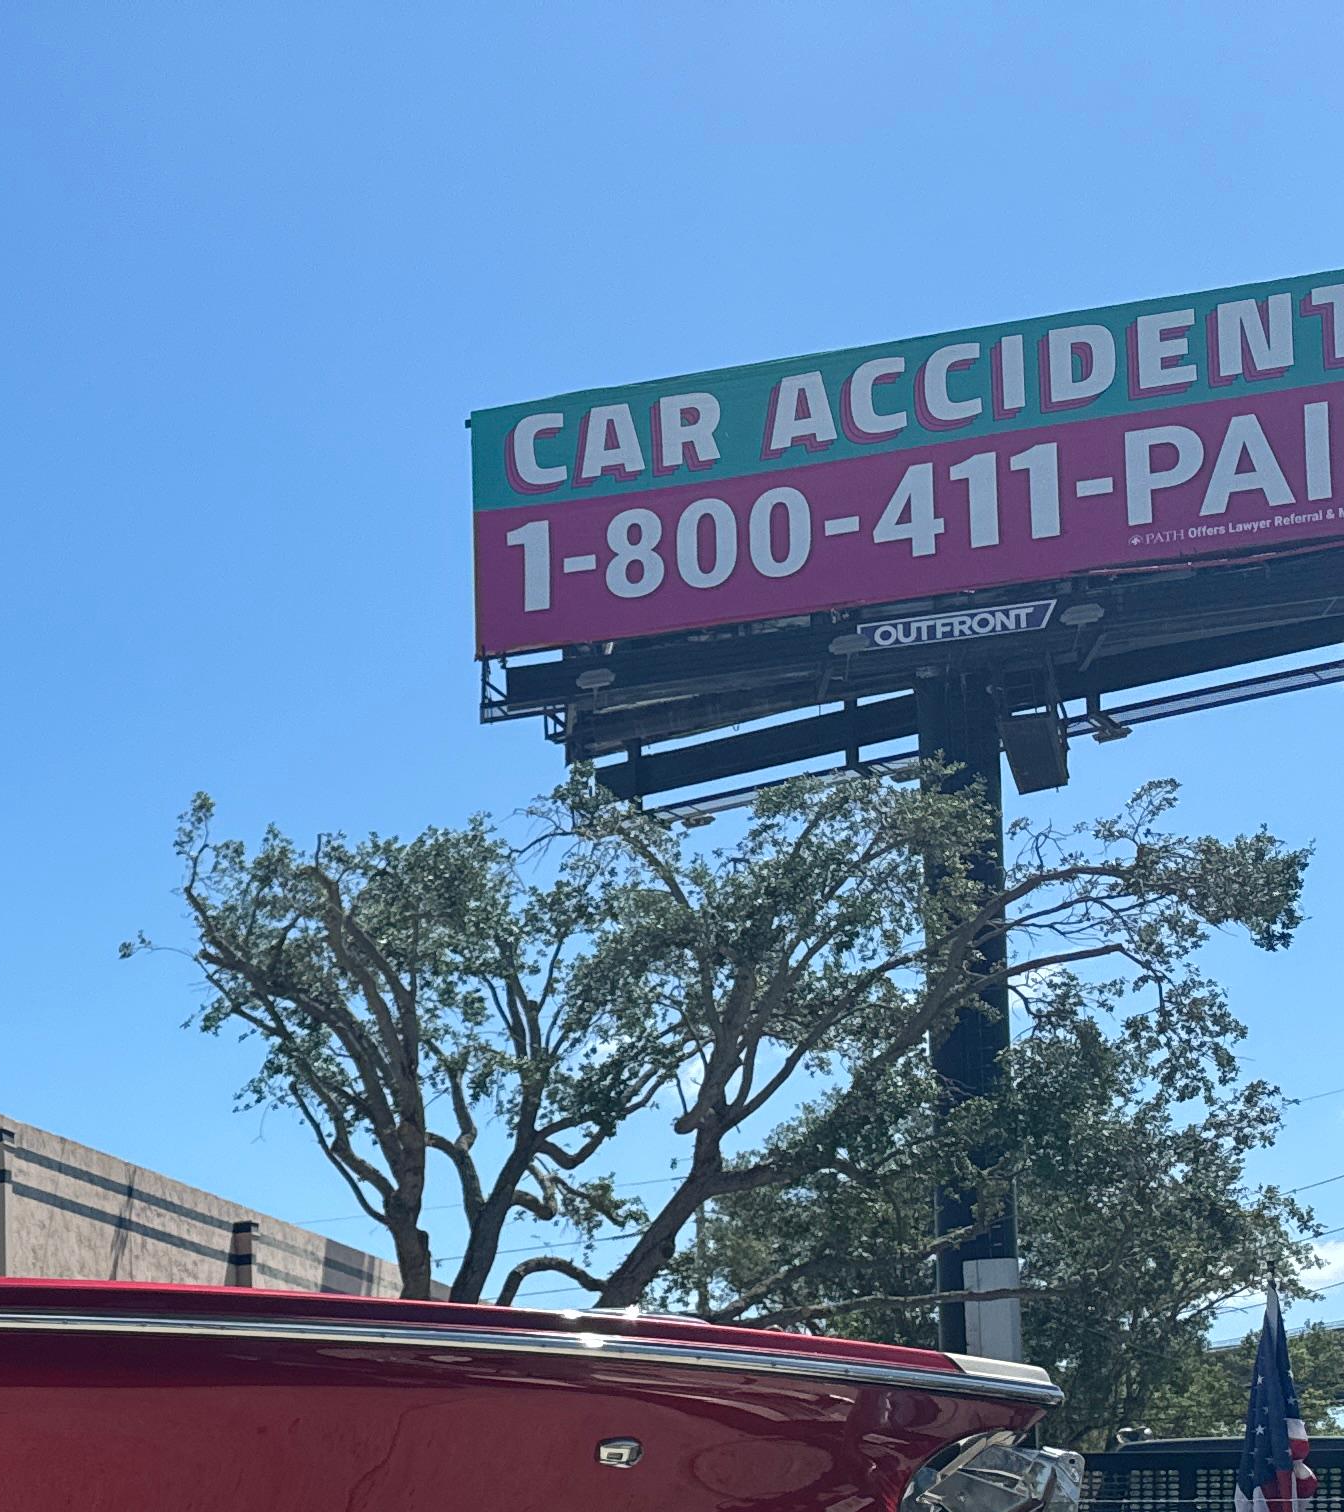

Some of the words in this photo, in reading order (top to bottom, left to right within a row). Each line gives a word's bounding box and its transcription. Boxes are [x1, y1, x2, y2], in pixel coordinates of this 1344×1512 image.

[509, 391, 723, 490] CAR
[1146, 529, 1185, 545] PATH
[1188, 524, 1226, 538] Offers
[1228, 518, 1272, 536] Lawyer
[1274, 509, 1323, 526] Referral
[1326, 508, 1335, 519] &
[873, 606, 1034, 646] OUTFRONT
